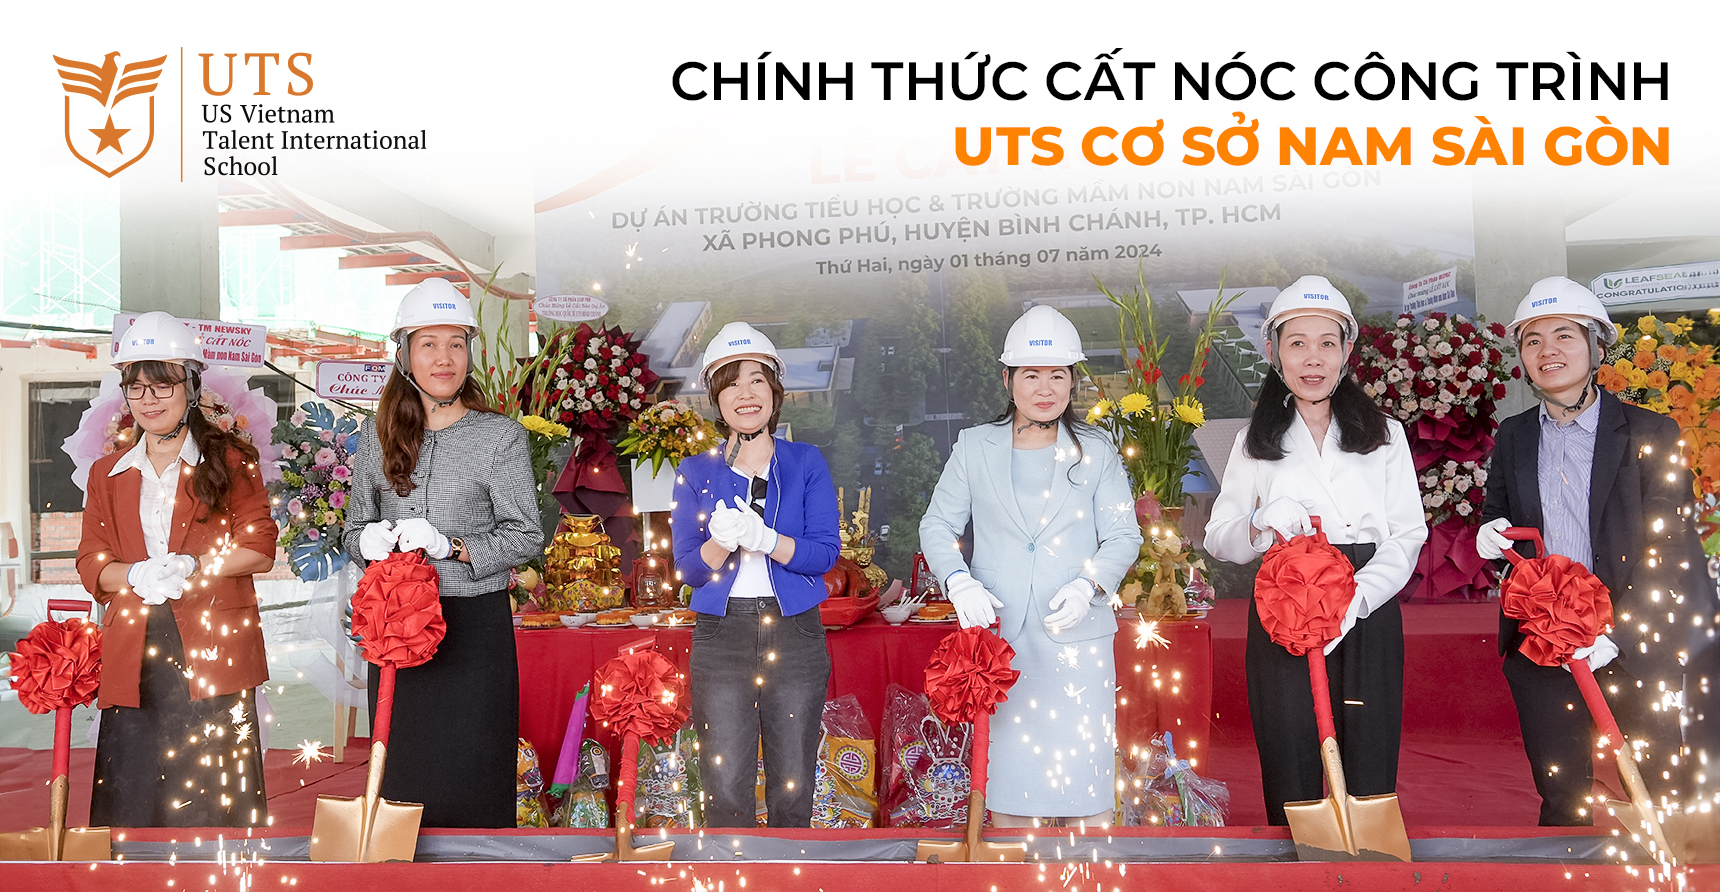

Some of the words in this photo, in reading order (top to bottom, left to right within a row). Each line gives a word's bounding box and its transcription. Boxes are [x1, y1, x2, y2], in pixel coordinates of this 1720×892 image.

[611, 207, 648, 233] DỰ
[653, 205, 688, 228] ÁN
[694, 201, 798, 225] TRƯỜNG
[804, 194, 859, 219] TIỂU
[867, 194, 921, 220] HỌC
[929, 194, 945, 212] &
[951, 186, 1059, 211] TRƯỜNG
[1067, 178, 1129, 204] MẦM
[1137, 179, 1196, 200] NON
[1203, 175, 1265, 198] NAM
[1272, 168, 1314, 192] SÀI
[1321, 165, 1382, 189] GÒN
[702, 228, 736, 252] XÃ
[742, 228, 831, 250] PHONG
[838, 221, 897, 246] PHÚ,
[904, 216, 990, 243] HUYỆN
[998, 211, 1061, 236] BÌNH
[1068, 206, 1169, 232] CHÁNH,
[1175, 207, 1215, 227] TP.
[1221, 203, 1282, 225] HCM
[815, 257, 852, 275] Thứ
[857, 256, 893, 275] Hai,
[898, 255, 945, 276] ngày
[949, 254, 969, 269] 01
[974, 250, 1031, 270] tháng
[1037, 248, 1060, 264] 07
[1065, 245, 1109, 263] năm
[1114, 243, 1163, 261] 2024
[1303, 293, 1330, 301] VISITOR
[1531, 297, 1558, 308] VISITOR
[432, 302, 457, 310] VISITOR
[198, 324, 212, 332] TM
[214, 325, 252, 335] NEWSKY
[206, 334, 228, 346] CẤT
[228, 336, 252, 348] NÓC
[728, 338, 751, 347] VISITOR
[337, 372, 368, 382] CÔNG
[329, 383, 368, 395] Chúc
